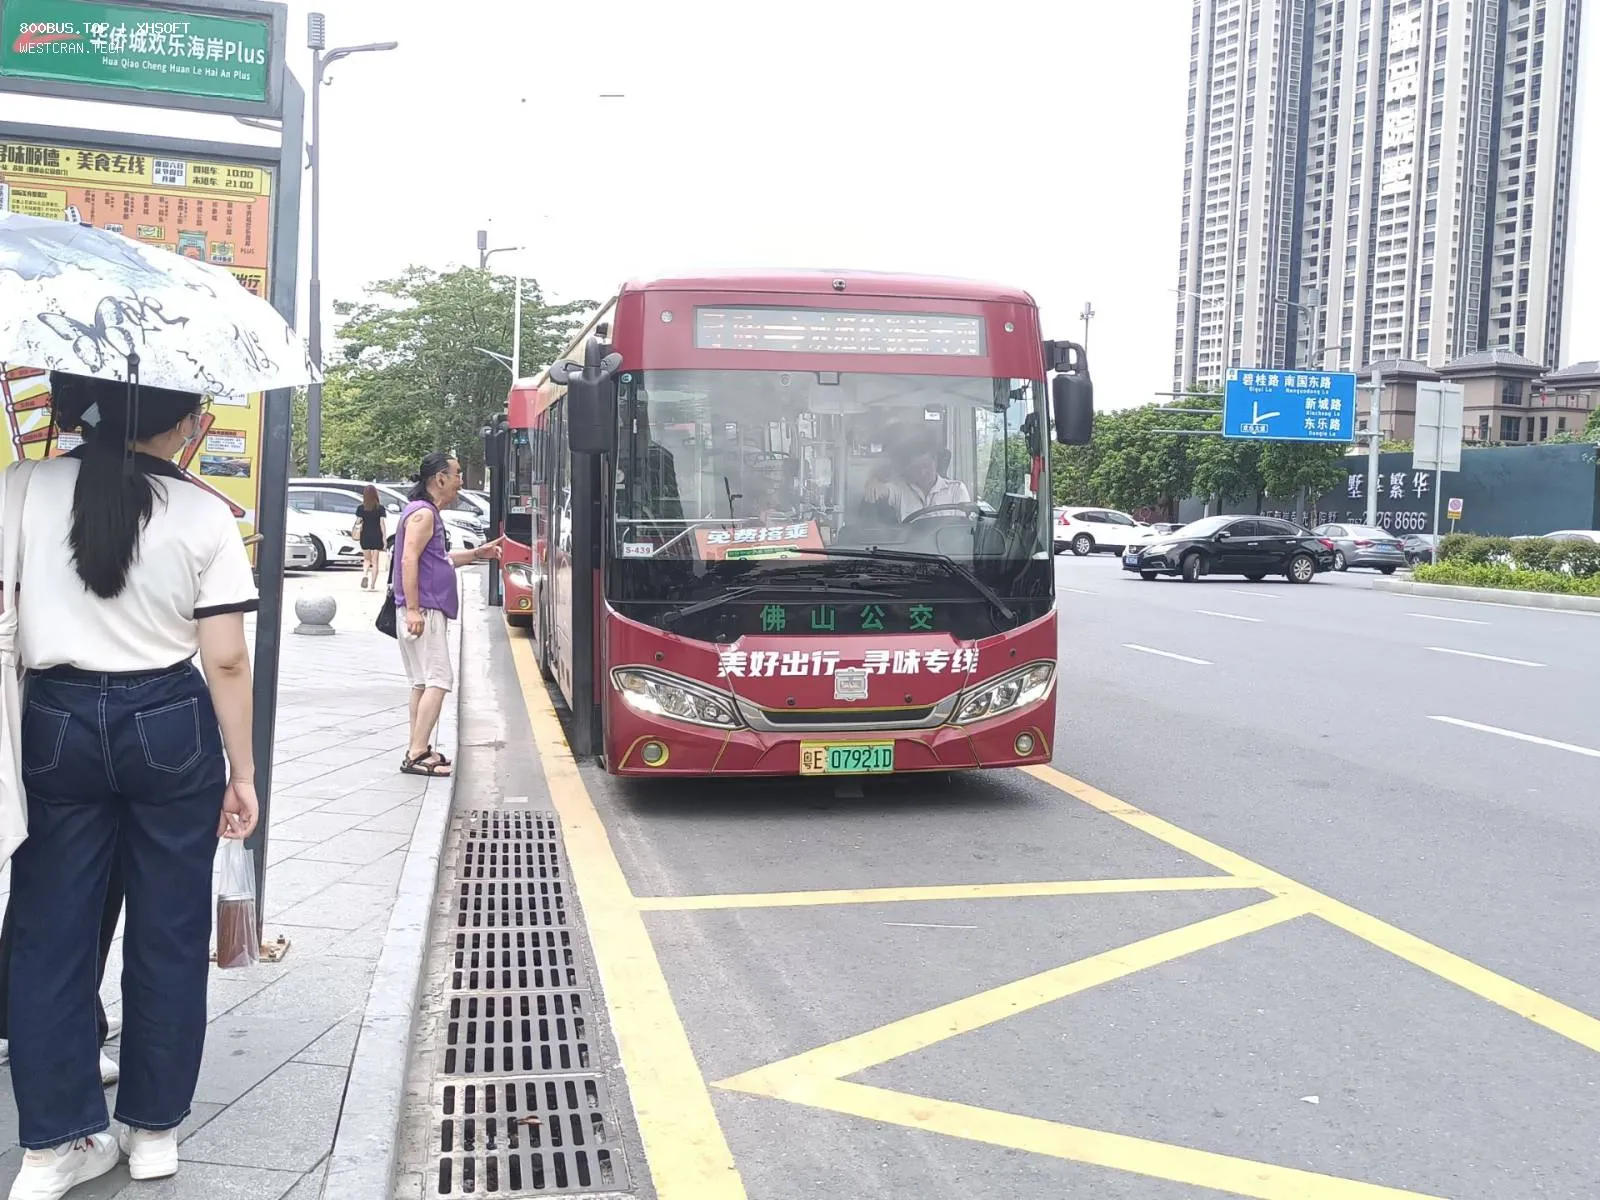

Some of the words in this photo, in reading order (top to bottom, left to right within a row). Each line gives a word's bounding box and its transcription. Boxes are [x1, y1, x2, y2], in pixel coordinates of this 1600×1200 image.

[90, 26, 265, 66] 华侨城欢乐海岸Plus
[102, 56, 118, 66] Hua
[121, 58, 140, 69] Qiao
[142, 60, 167, 73] Cheng
[170, 64, 190, 74] Huan
[193, 65, 202, 75] Le
[205, 68, 218, 77] Hai
[221, 69, 231, 78] An
[234, 70, 251, 81] Plus
[1242, 373, 1279, 387] 碧桂路
[1284, 374, 1331, 389] 南国东路
[1305, 397, 1341, 411] 新城路
[1304, 417, 1341, 431] 东乐路
[1394, 511, 1425, 530] 8666
[706, 523, 809, 544] 免费搭乘
[760, 604, 935, 632] 佛山公交
[717, 650, 841, 677] 美好出行
[862, 648, 979, 675] 寻味专线
